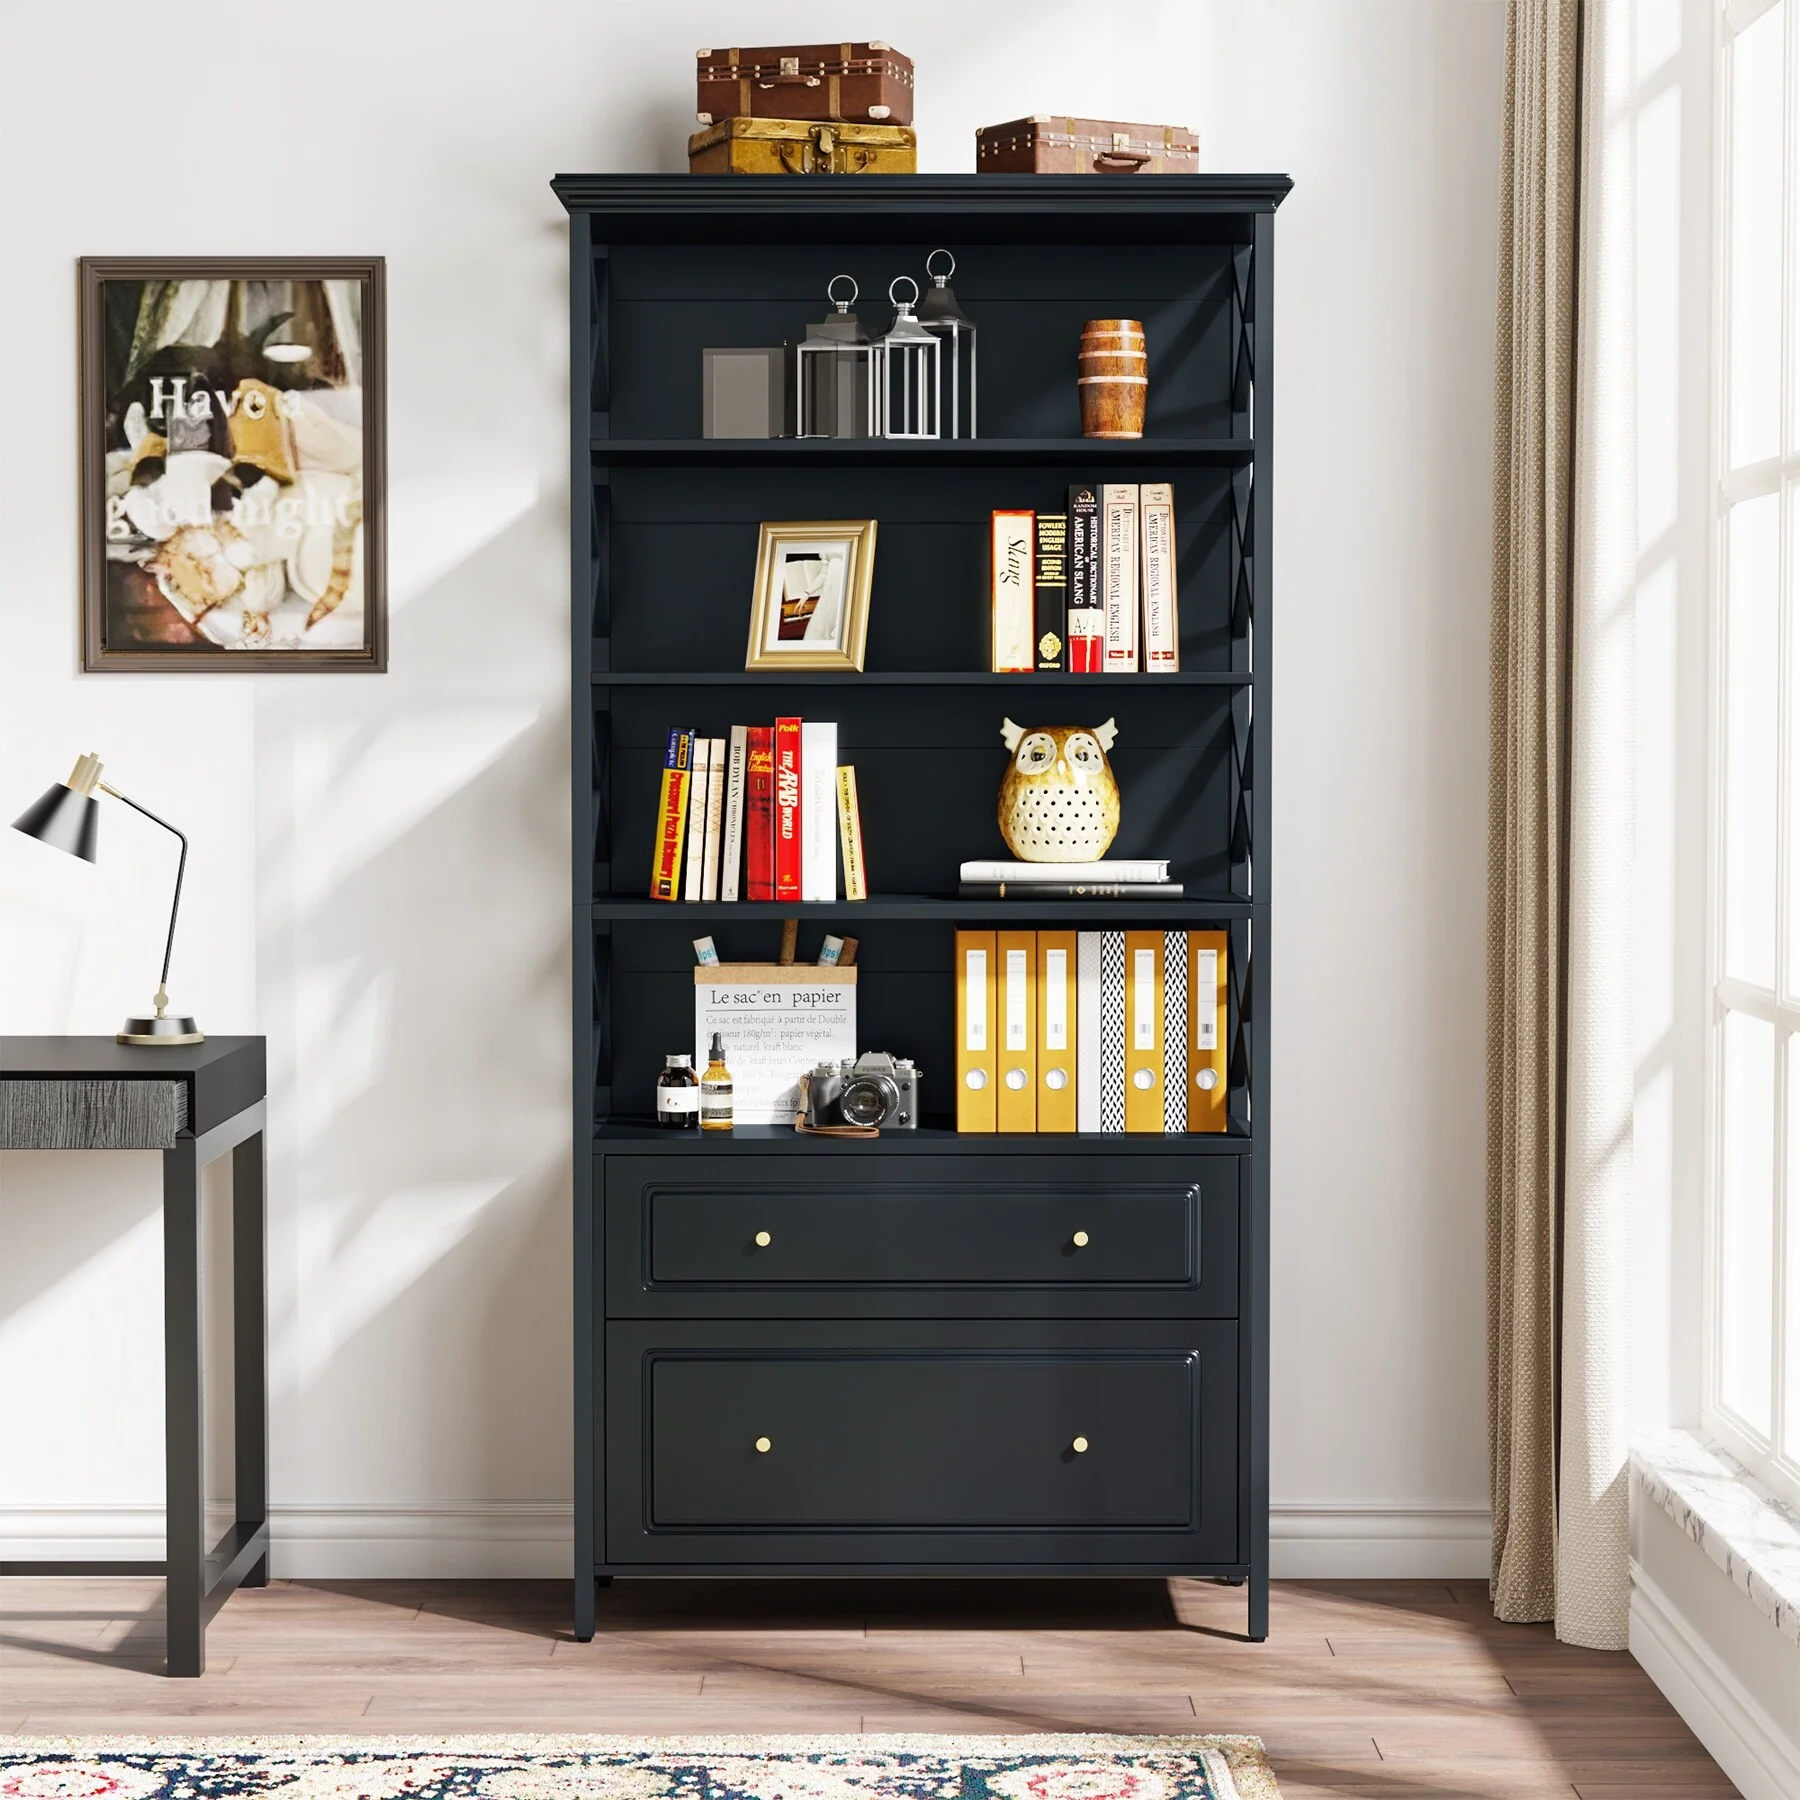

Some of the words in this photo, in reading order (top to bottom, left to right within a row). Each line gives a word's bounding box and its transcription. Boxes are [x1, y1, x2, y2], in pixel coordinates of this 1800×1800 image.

[150, 376, 266, 420] Have
[1074, 517, 1084, 569] AMERICAN
[1090, 516, 1098, 560] HISTORICAL
[1111, 508, 1120, 553] AMERICAN
[1149, 513, 1158, 554] AMERICAN
[999, 536, 1027, 587] Slang
[1110, 556, 1120, 601] REGIONAL
[1150, 557, 1159, 598] REGIONAL
[1073, 571, 1084, 605] SLANG
[1089, 562, 1098, 605] DICTIONARY
[1110, 604, 1119, 642] ENGLISH
[1151, 601, 1160, 637] ENGLISH
[779, 724, 799, 732] Polk
[668, 733, 678, 766] Complete
[733, 746, 741, 764] BOB
[748, 761, 774, 773] Literature
[750, 751, 772, 765] English
[782, 750, 793, 769] THE
[667, 772, 684, 814] Crossword
[731, 767, 740, 799] DYLAN
[778, 766, 798, 809] ARAB
[665, 815, 680, 839] Puzzle
[730, 800, 738, 844] CHRONICLES
[782, 806, 793, 839] WORLD
[660, 841, 677, 879] Dictionary
[711, 991, 729, 1004] Le
[763, 993, 781, 1003] en
[793, 989, 842, 1007] papier
[706, 1016, 717, 1024] Ce
[744, 1015, 775, 1026] fabriqué
[778, 1016, 782, 1024] à
[784, 1015, 805, 1026] partir
[807, 1015, 816, 1024] de
[818, 1015, 847, 1024] Double
[706, 1029, 740, 1040] épisseur
[780, 1030, 804, 1040] papier
[806, 1028, 834, 1040] végétal.
[763, 1041, 781, 1051] kraft
[783, 1042, 803, 1051] blanc
